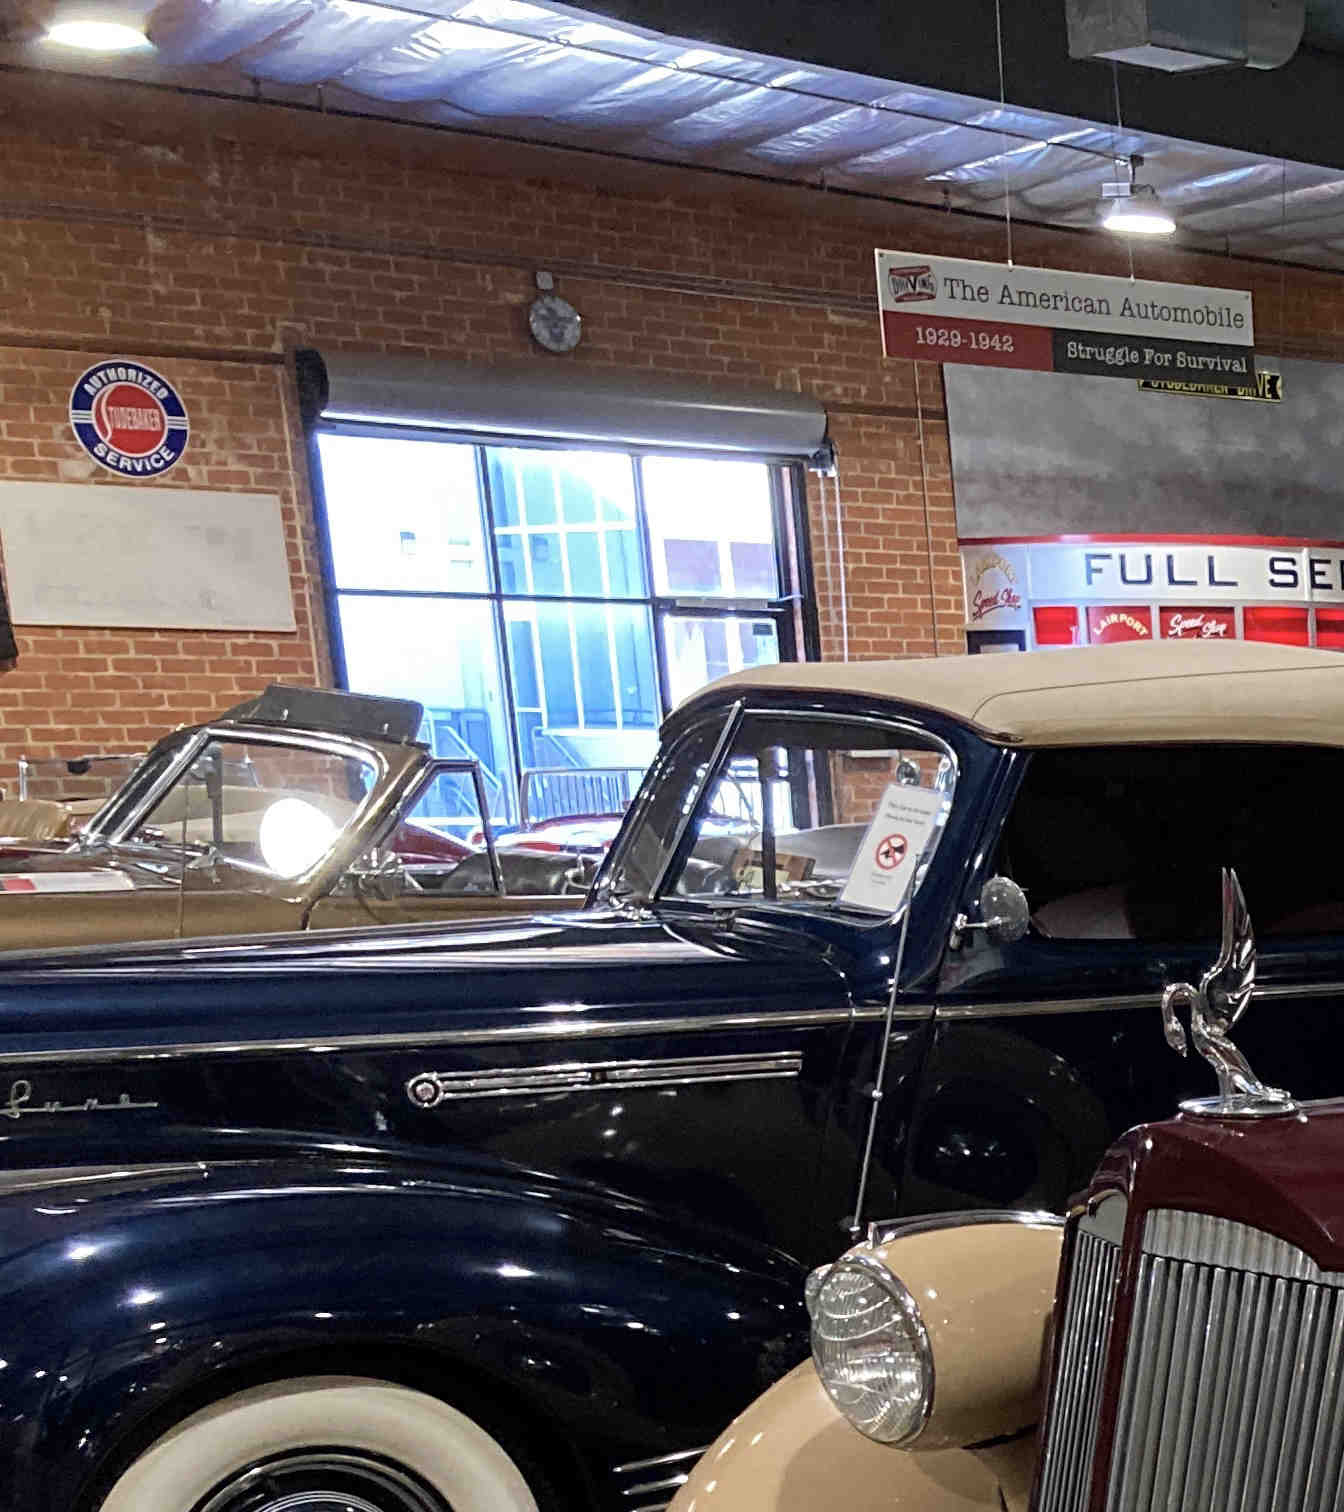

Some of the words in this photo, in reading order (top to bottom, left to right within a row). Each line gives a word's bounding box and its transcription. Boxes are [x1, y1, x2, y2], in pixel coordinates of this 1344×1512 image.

[944, 278, 991, 303] The
[997, 284, 1112, 316] American
[1120, 297, 1245, 329] Automobile
[915, 326, 1015, 353] 1929-1942
[1067, 341, 1140, 367] Struggle
[1143, 349, 1172, 367] For
[1176, 353, 1248, 373] Survival
[83, 367, 169, 399] AUTHORIZED
[93, 443, 176, 472] SERVICE
[1084, 553, 1239, 587] FULL
[1093, 613, 1149, 636] LAIRPORT
[1168, 614, 1205, 636] Speed
[1202, 618, 1227, 638] Shop
